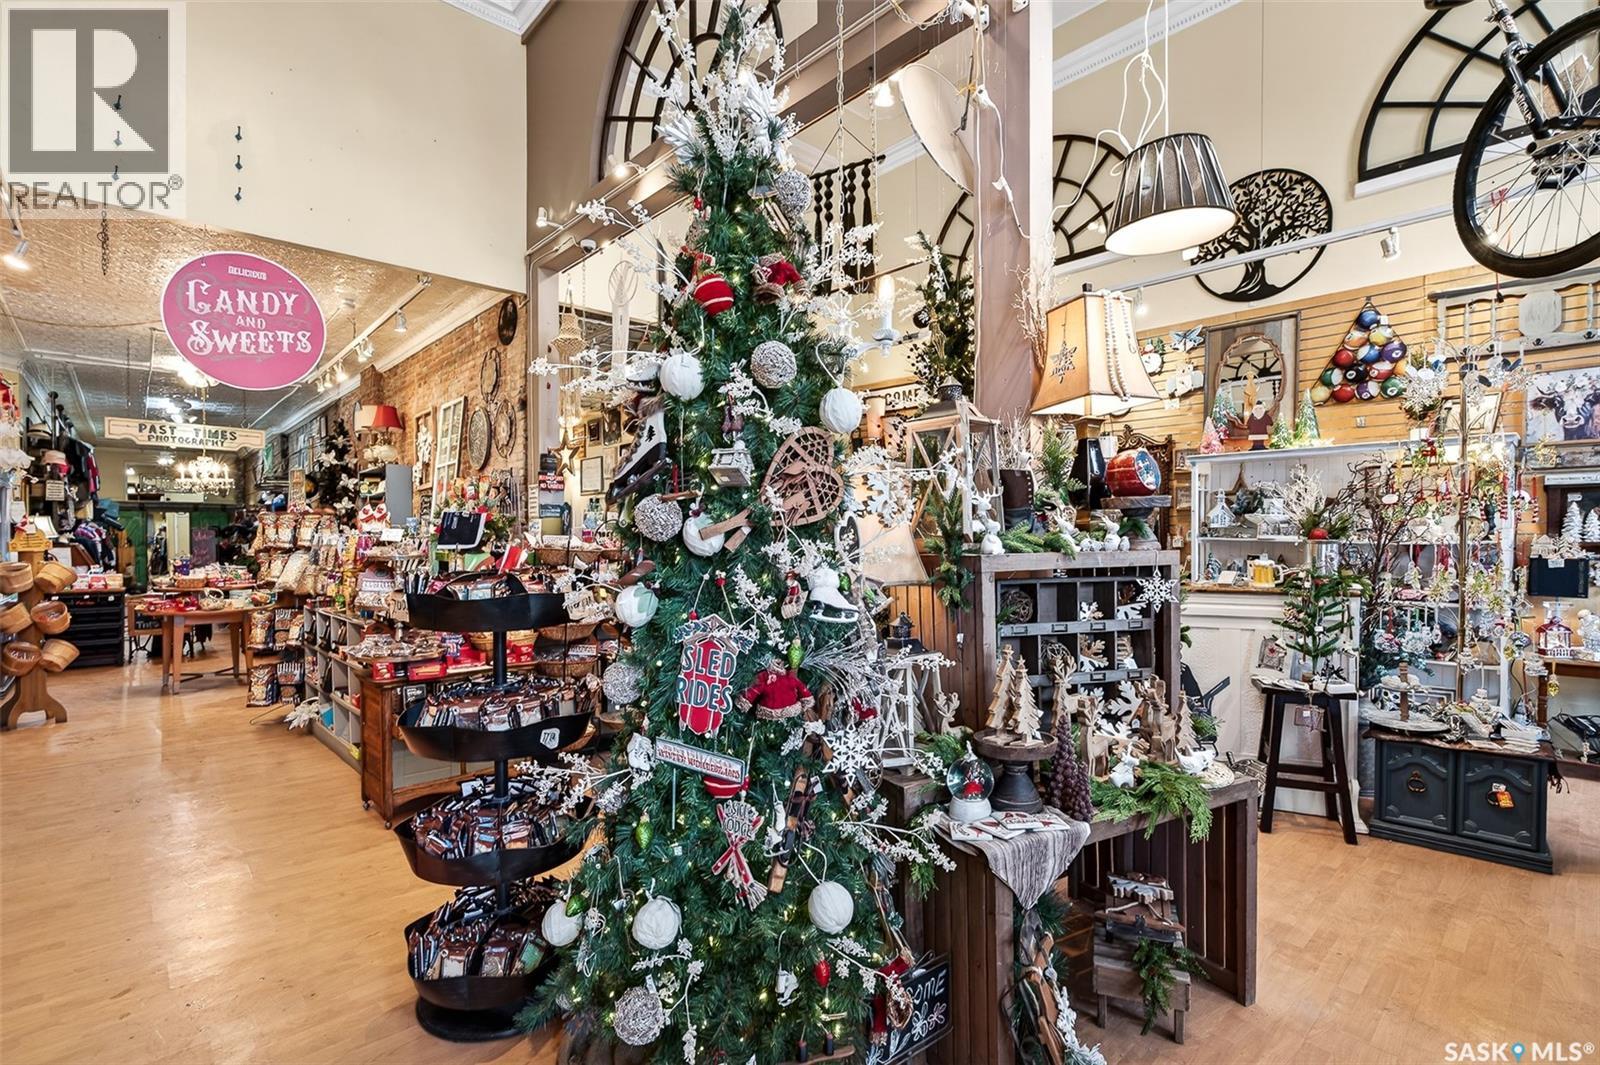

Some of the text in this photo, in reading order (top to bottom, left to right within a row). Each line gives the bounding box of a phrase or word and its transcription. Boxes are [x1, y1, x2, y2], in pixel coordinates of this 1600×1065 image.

[186, 279, 299, 316] CANDY
[235, 315, 266, 330] AND
[186, 319, 312, 356] SWEETS
[884, 388, 921, 406] COME
[138, 423, 238, 441] PAST TIMES
[147, 434, 226, 447] PHOTOGRAPHY
[681, 644, 737, 680] SLED
[675, 675, 733, 715] RIDES
